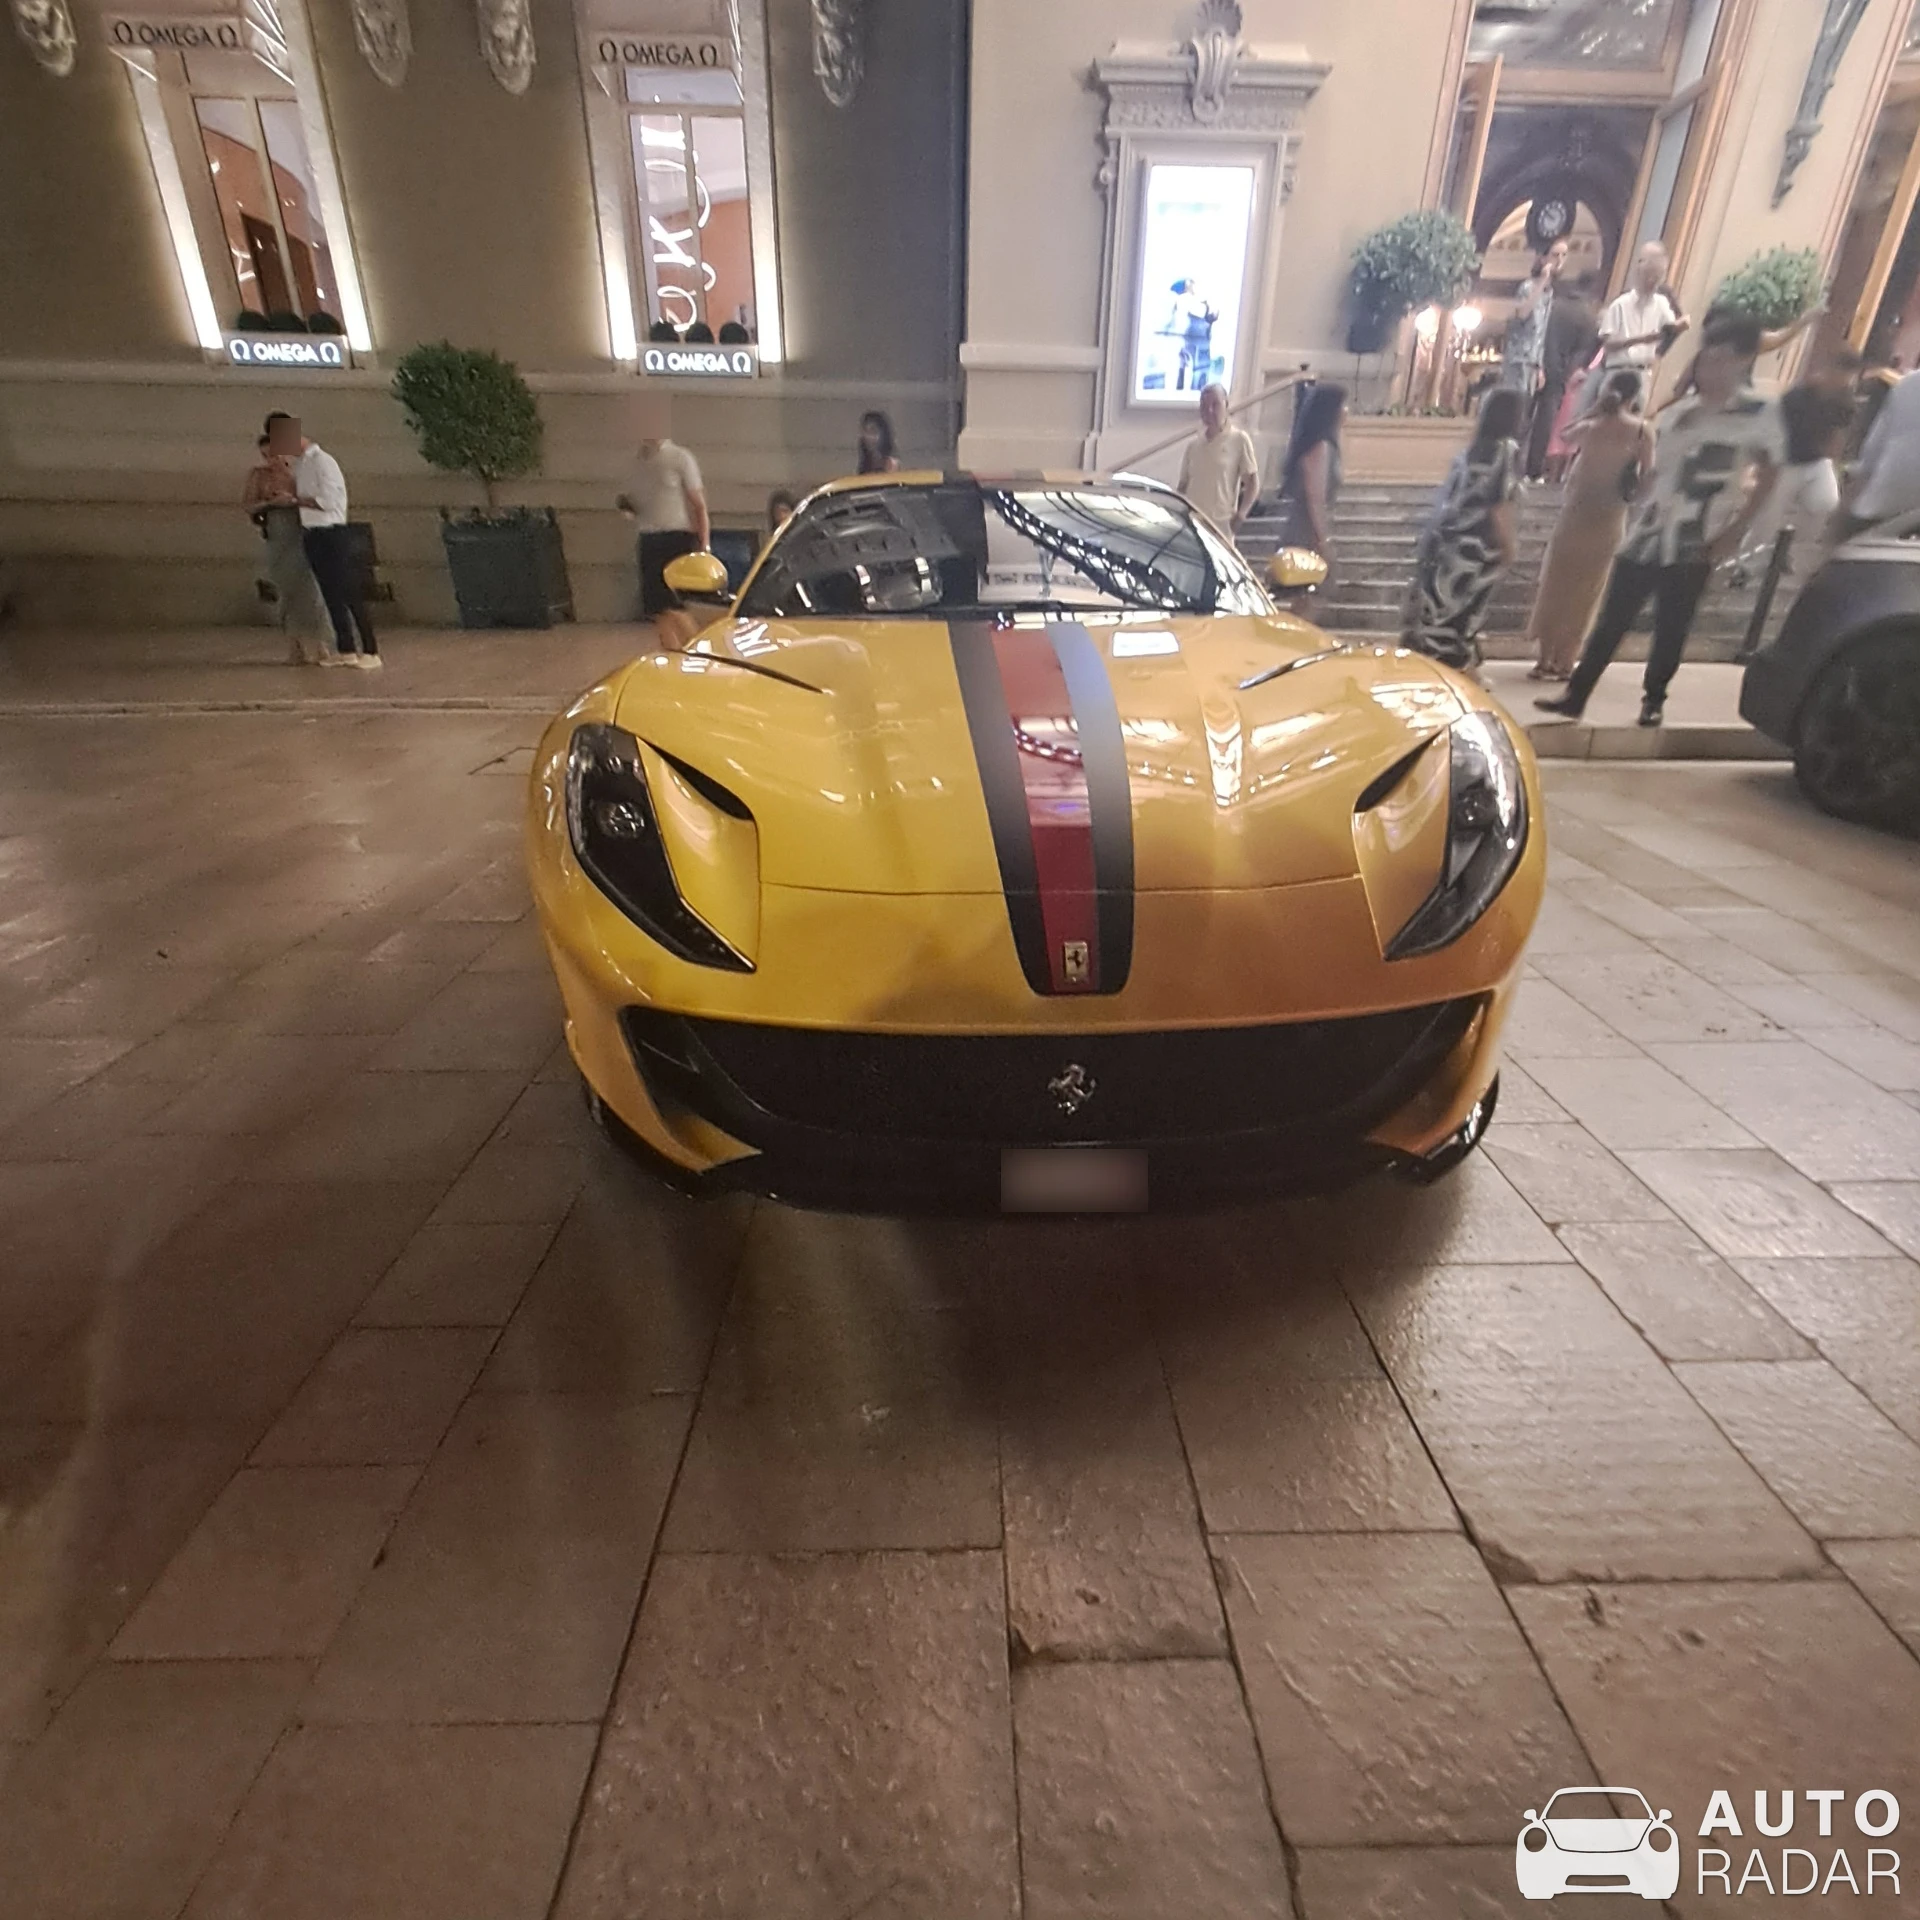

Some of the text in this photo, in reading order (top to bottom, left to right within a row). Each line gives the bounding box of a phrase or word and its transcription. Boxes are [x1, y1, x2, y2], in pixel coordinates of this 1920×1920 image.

[139, 24, 215, 48] OMEGA
[623, 43, 696, 65] OMEGA
[253, 342, 319, 362] OMEGA
[667, 352, 731, 373] OMEGA
